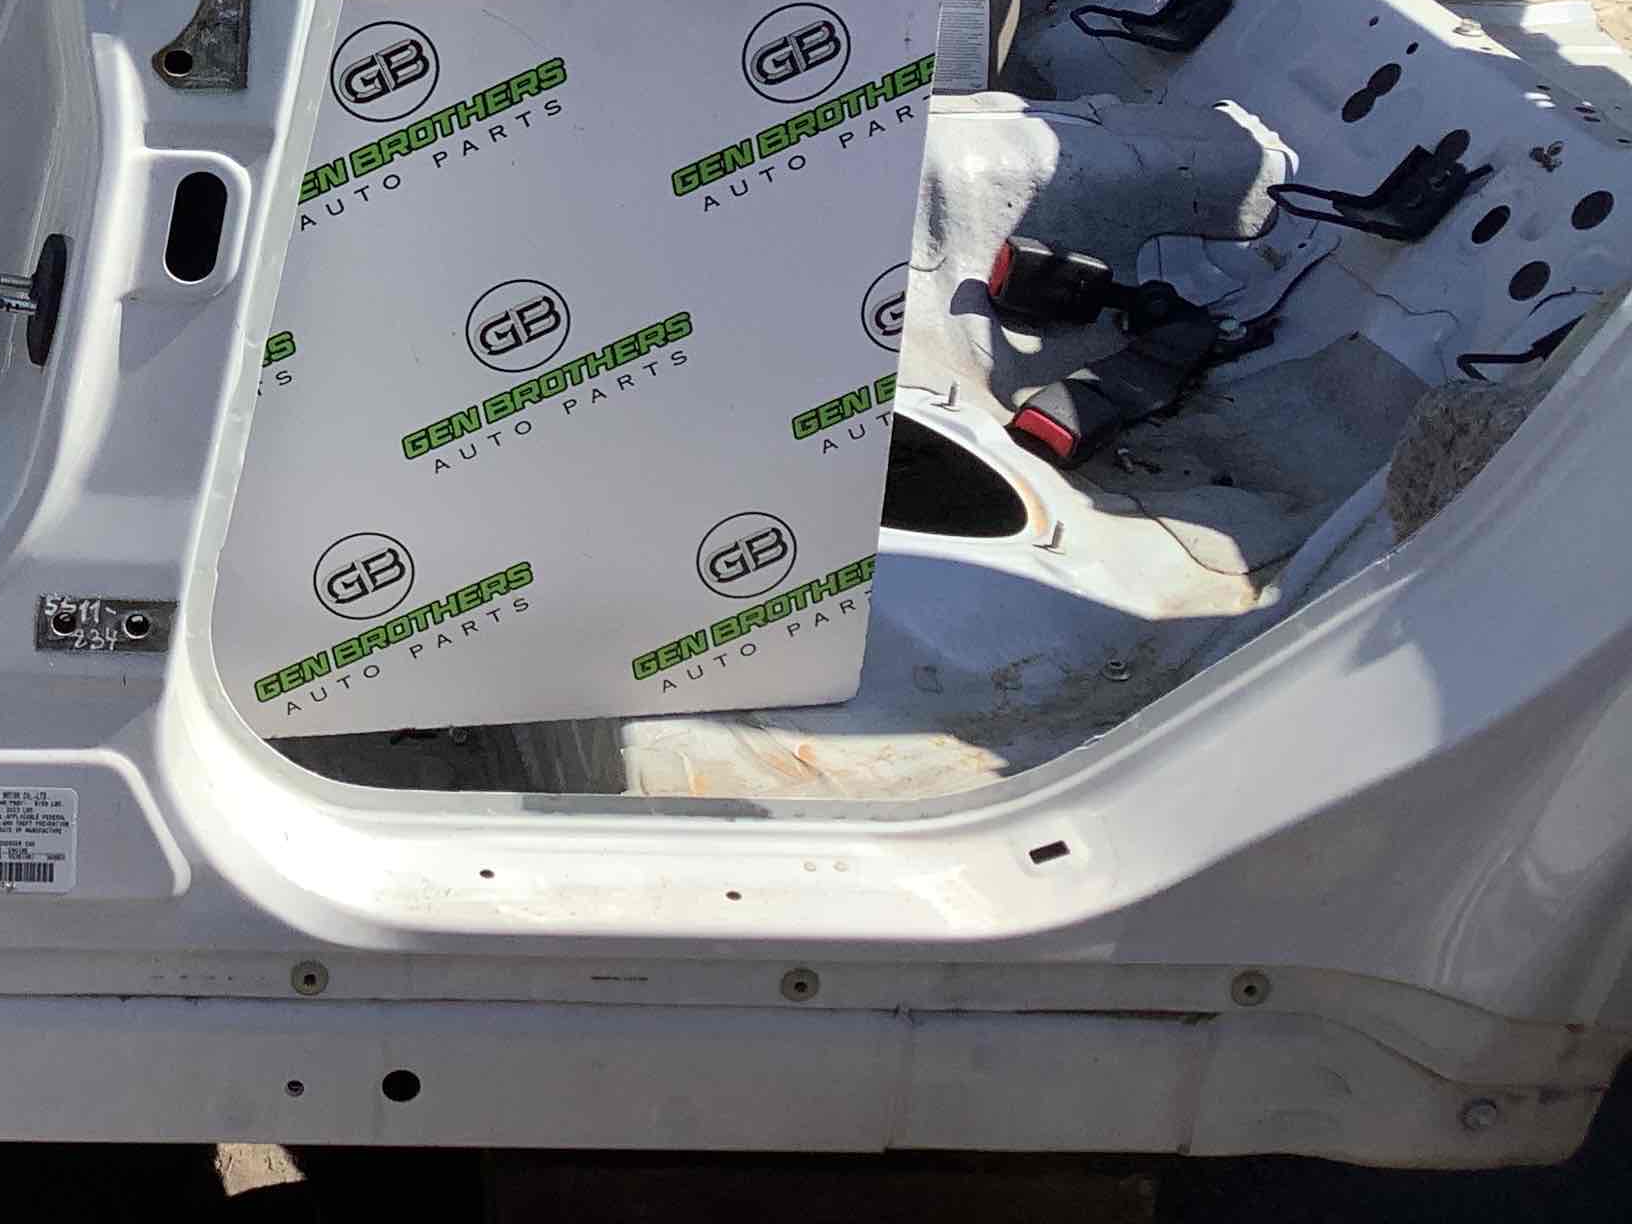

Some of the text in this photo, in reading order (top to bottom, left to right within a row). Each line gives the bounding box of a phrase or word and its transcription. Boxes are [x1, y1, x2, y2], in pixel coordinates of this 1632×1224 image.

[339, 39, 430, 103] GB
[751, 20, 841, 85] GB
[298, 57, 567, 205] EN BROTHERS
[301, 99, 563, 231] AUTO PARTS
[671, 52, 936, 197] GEN BROTHER
[703, 95, 932, 211] AUTO PAR
[475, 295, 561, 356] GB
[402, 312, 693, 460] GEN BROTHERS
[434, 350, 688, 474] AUTO PARTS
[792, 386, 871, 440] GEN
[821, 411, 893, 454] AUT
[321, 547, 406, 605] GB
[705, 527, 788, 584] GB
[254, 561, 534, 703] GEN BROTHERS
[285, 598, 529, 715] AUTO PARTS
[632, 553, 876, 681] GEN BROTHER
[661, 589, 873, 693] AUTO PAR
